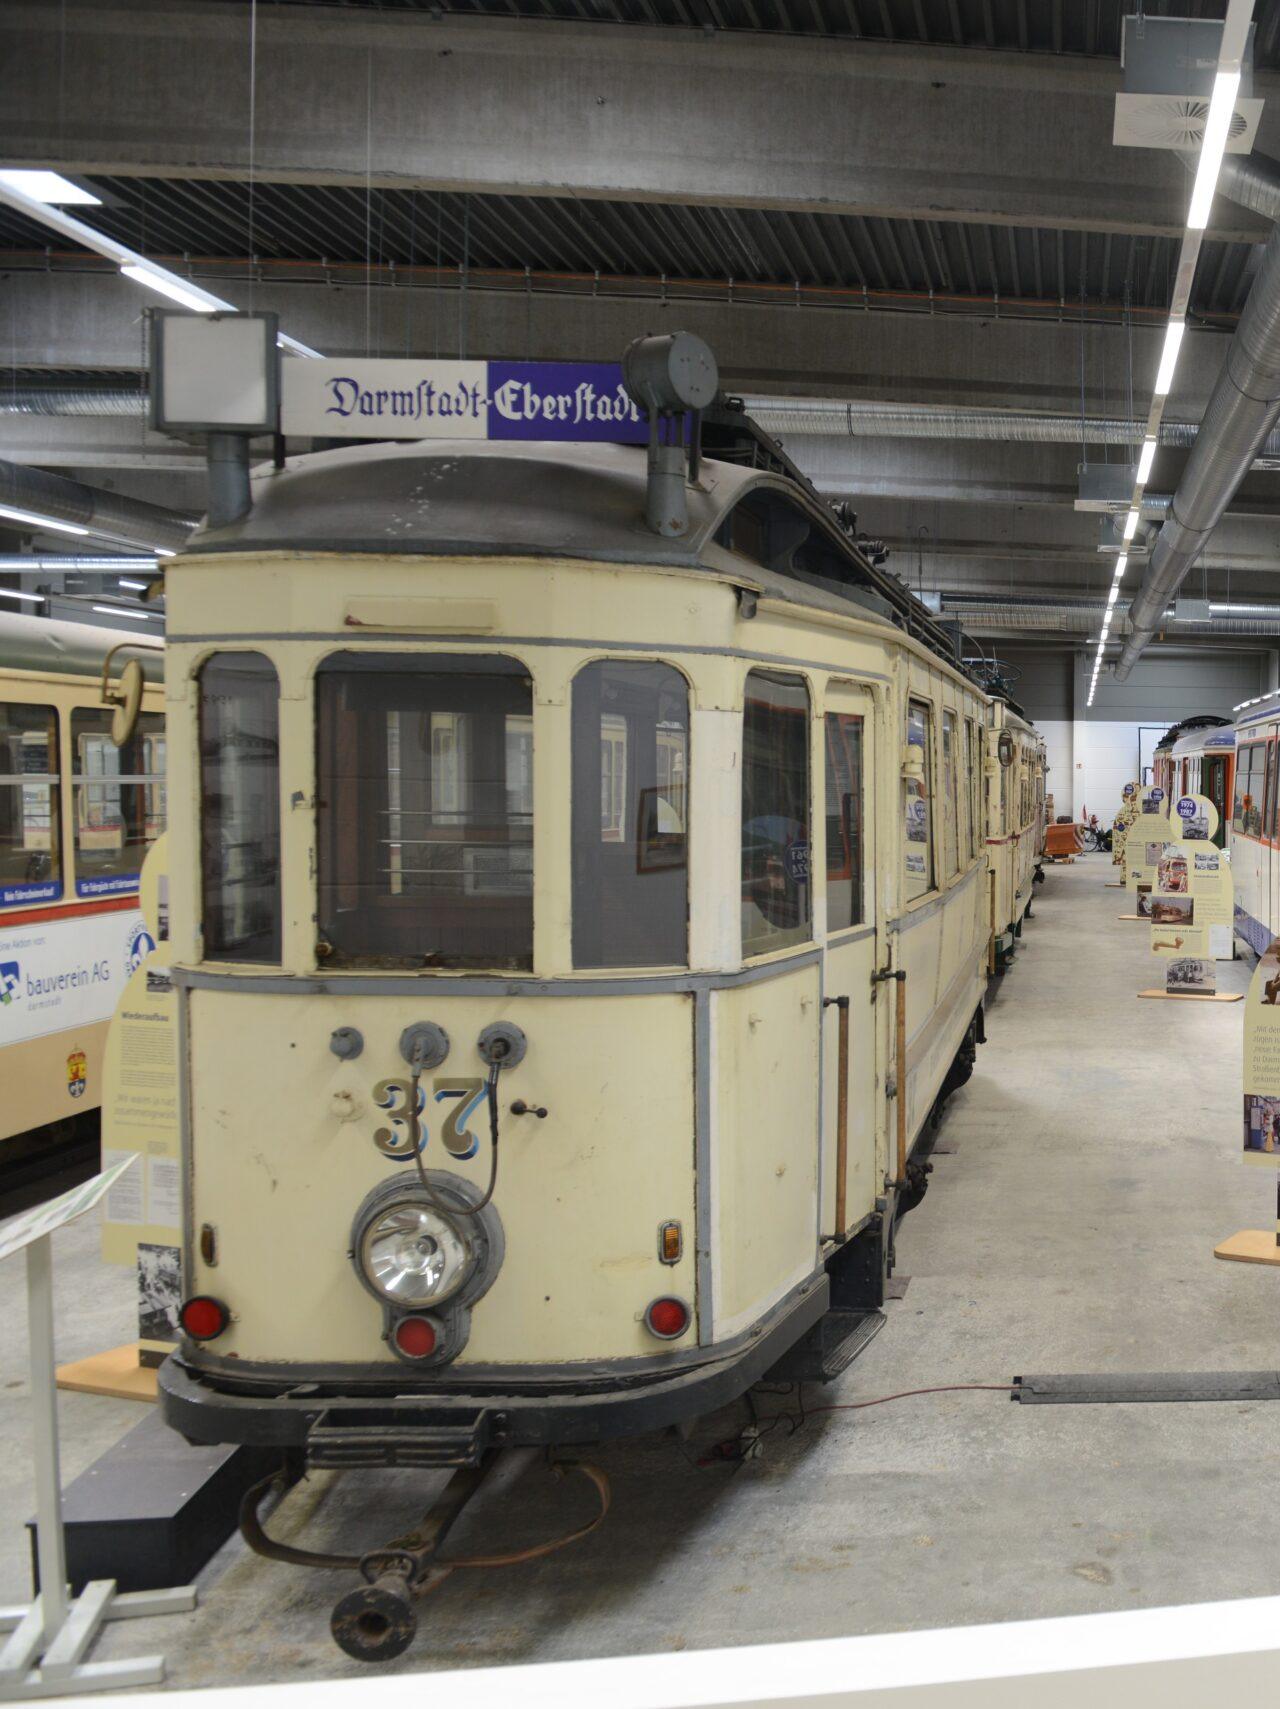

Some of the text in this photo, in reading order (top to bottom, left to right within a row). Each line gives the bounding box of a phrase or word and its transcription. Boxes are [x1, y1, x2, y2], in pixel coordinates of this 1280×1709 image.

[26, 960, 110, 997] bauverein AG
[371, 1077, 489, 1162] 37
